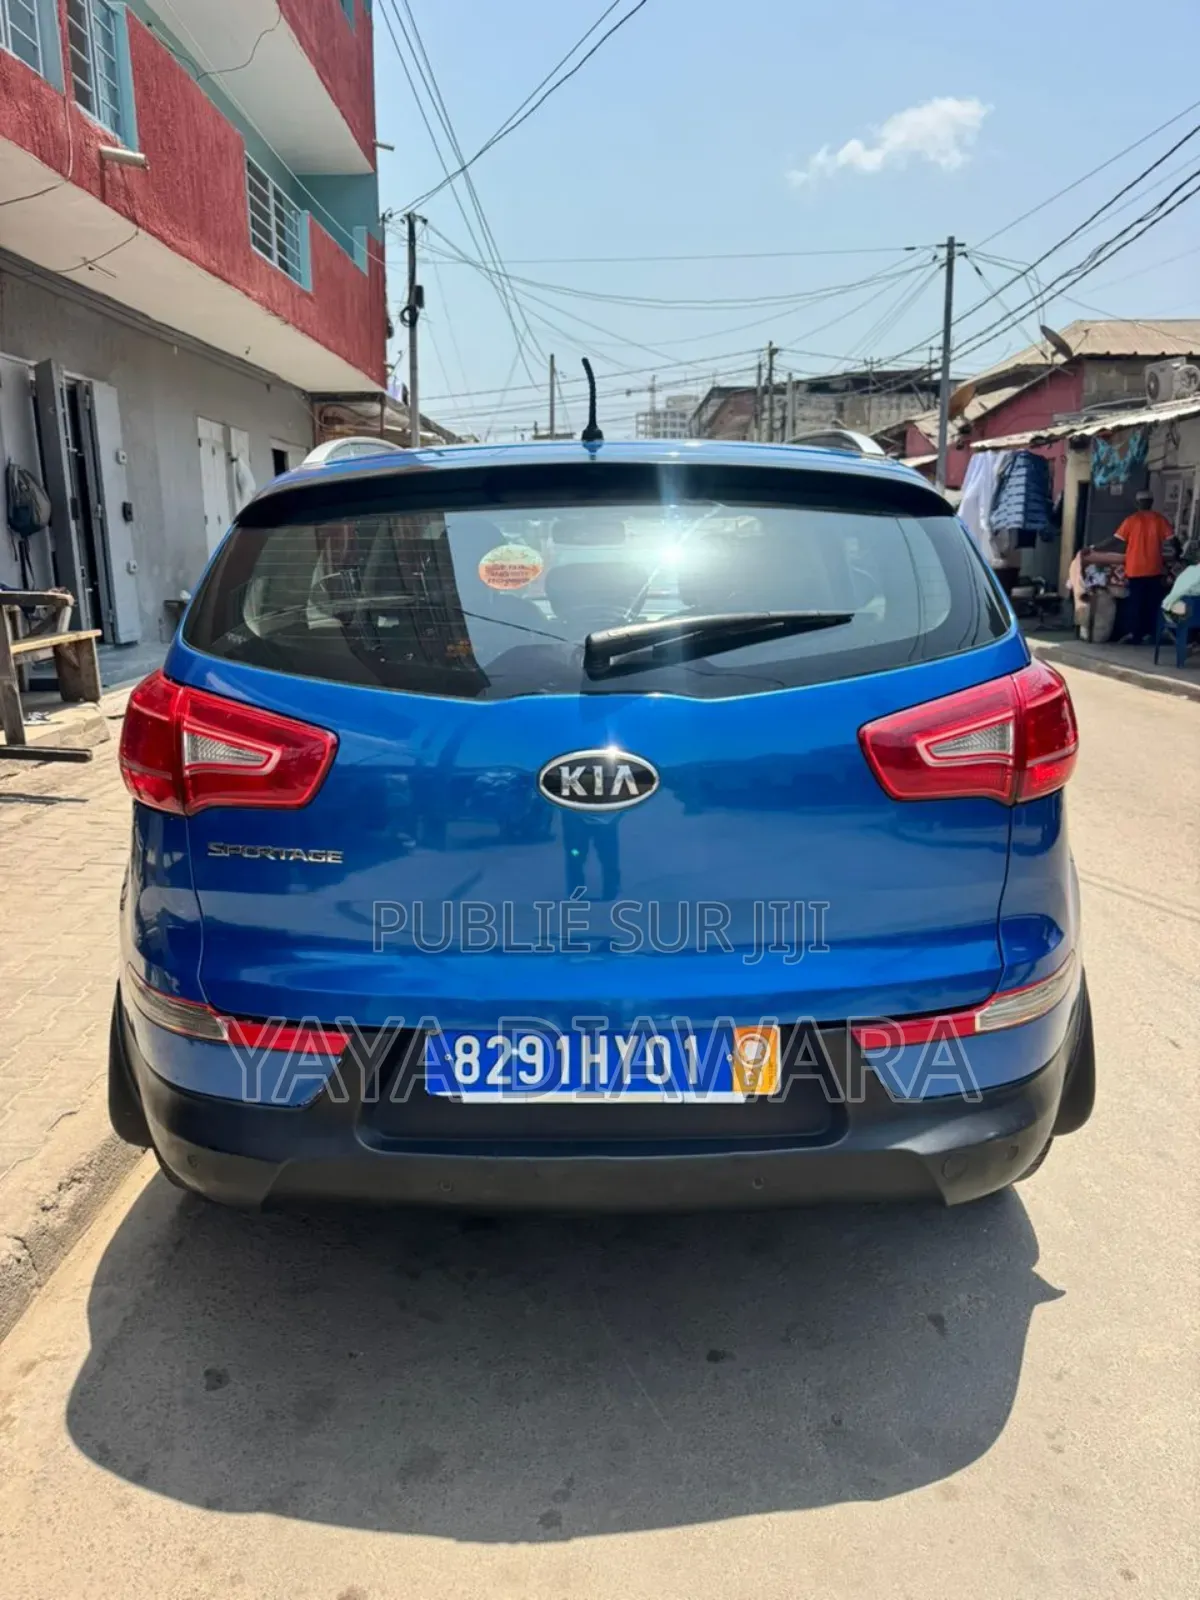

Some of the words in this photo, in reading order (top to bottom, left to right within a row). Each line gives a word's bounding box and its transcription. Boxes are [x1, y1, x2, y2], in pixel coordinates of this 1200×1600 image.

[560, 765, 640, 796] KIA
[207, 841, 343, 864] SPORTAGE
[454, 1034, 699, 1086] 8291HY01
